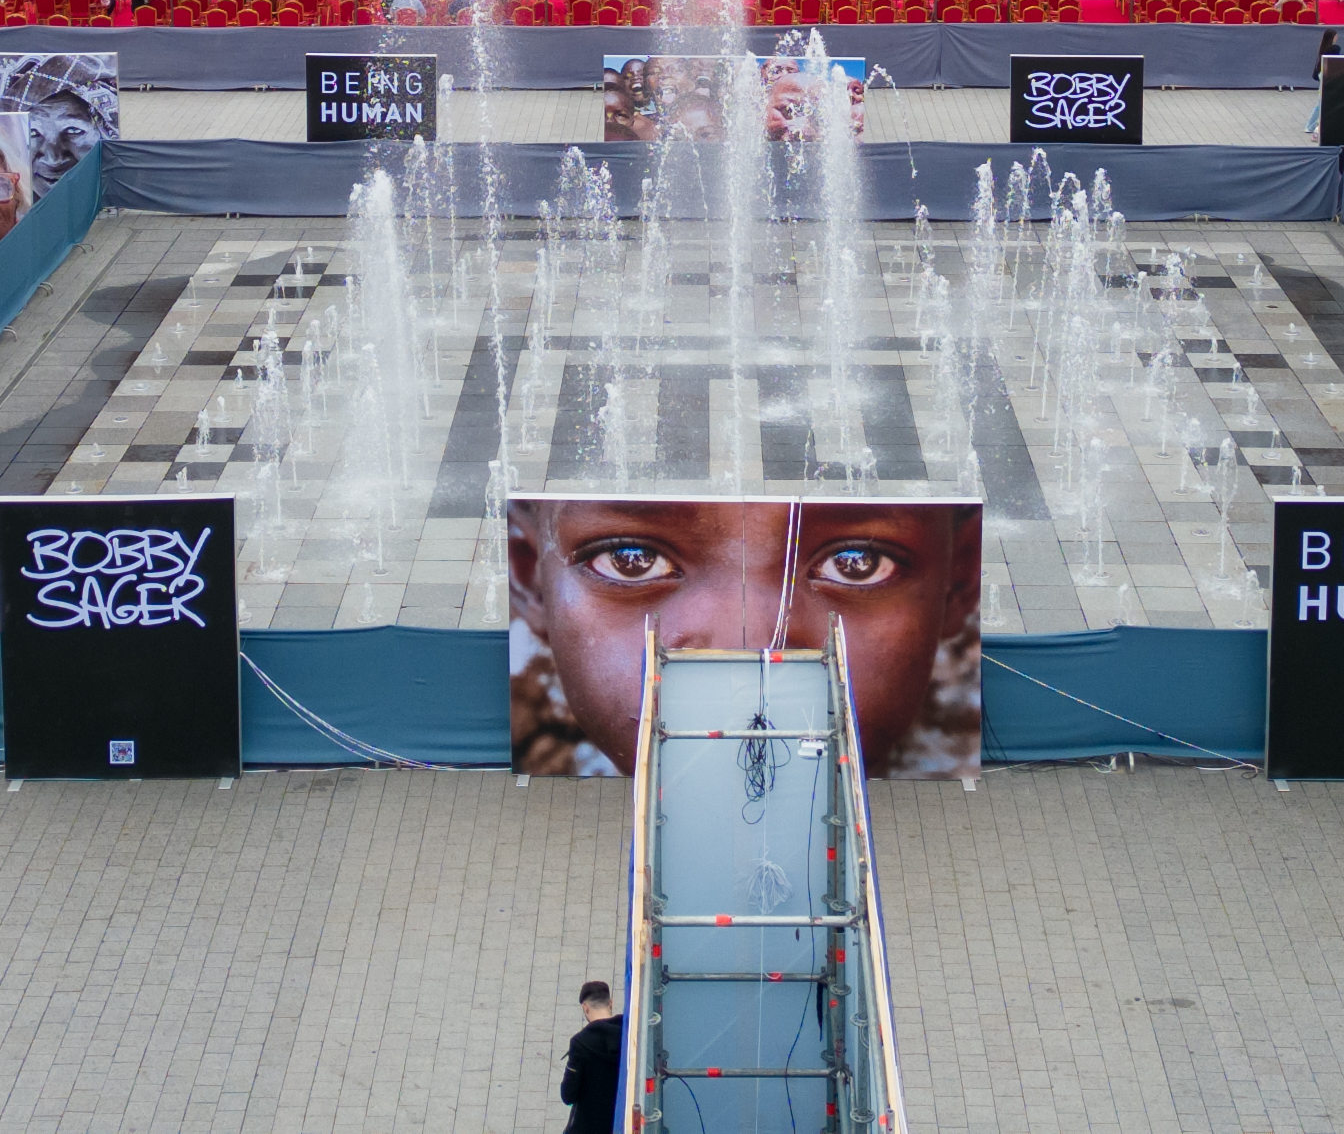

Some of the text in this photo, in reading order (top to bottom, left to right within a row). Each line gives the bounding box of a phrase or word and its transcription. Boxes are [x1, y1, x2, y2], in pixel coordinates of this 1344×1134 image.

[321, 72, 422, 94] BEING
[1024, 72, 1130, 105] BOBBY
[320, 102, 422, 123] HUMAN
[1025, 98, 1126, 130] SAGER
[20, 528, 210, 585] BOBBY
[26, 573, 206, 629] SAGER
